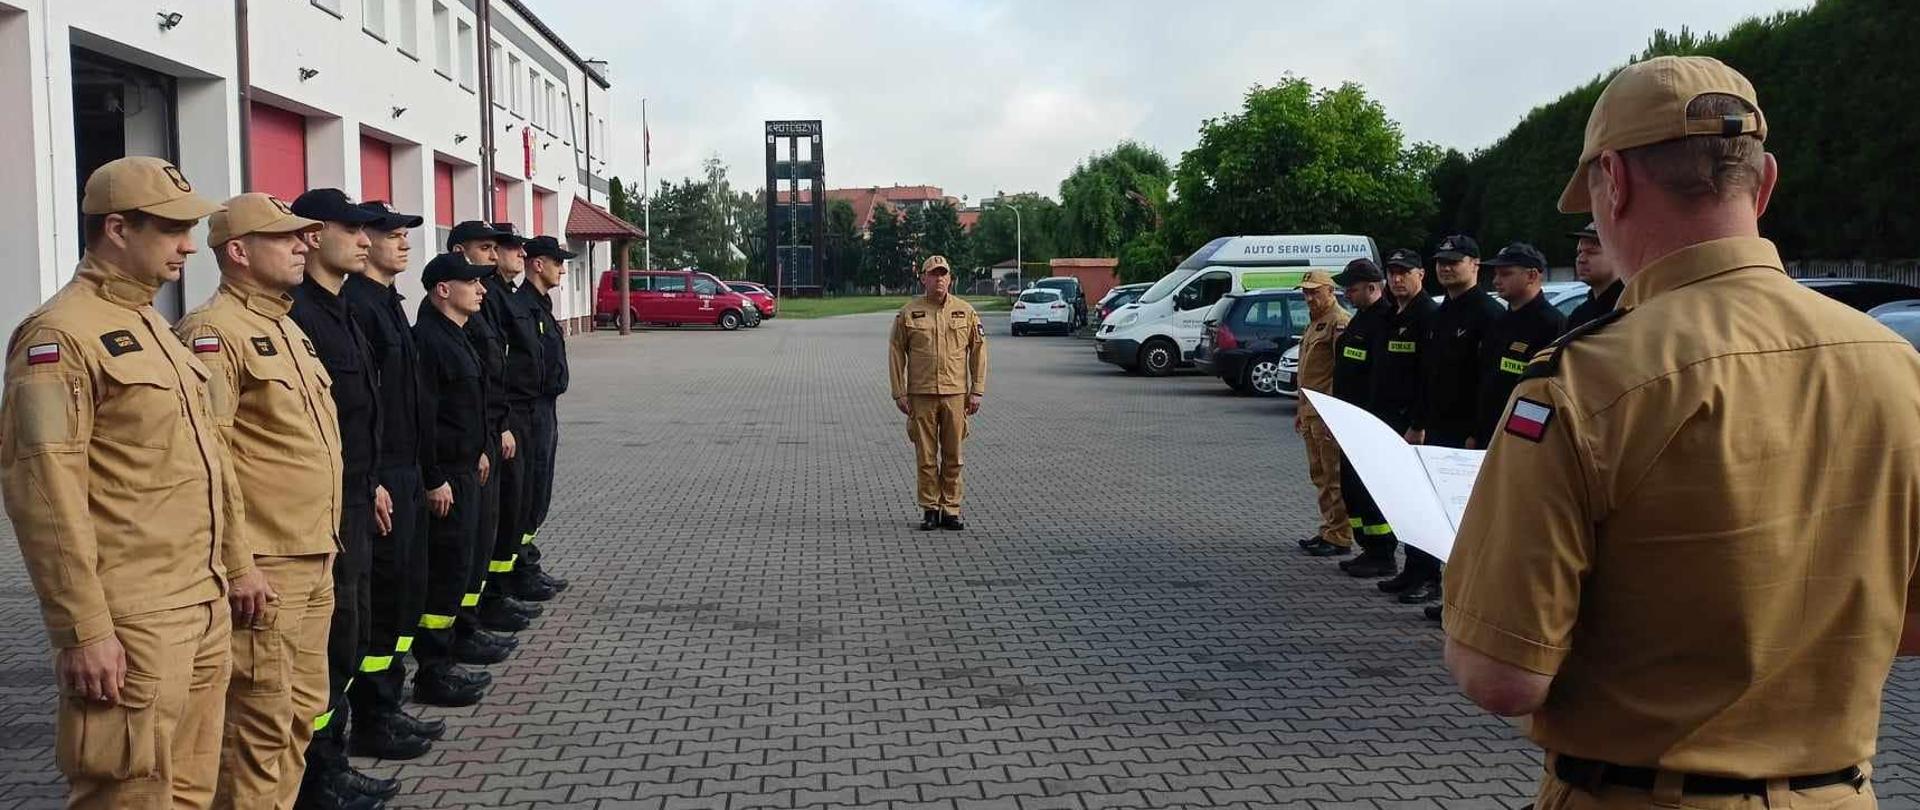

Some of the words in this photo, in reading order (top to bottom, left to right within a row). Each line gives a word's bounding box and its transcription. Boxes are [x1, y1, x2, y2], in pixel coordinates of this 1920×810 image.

[1244, 246, 1274, 255] AUTO
[1278, 245, 1322, 254] SERWIS
[1325, 244, 1367, 253] GOLINA
